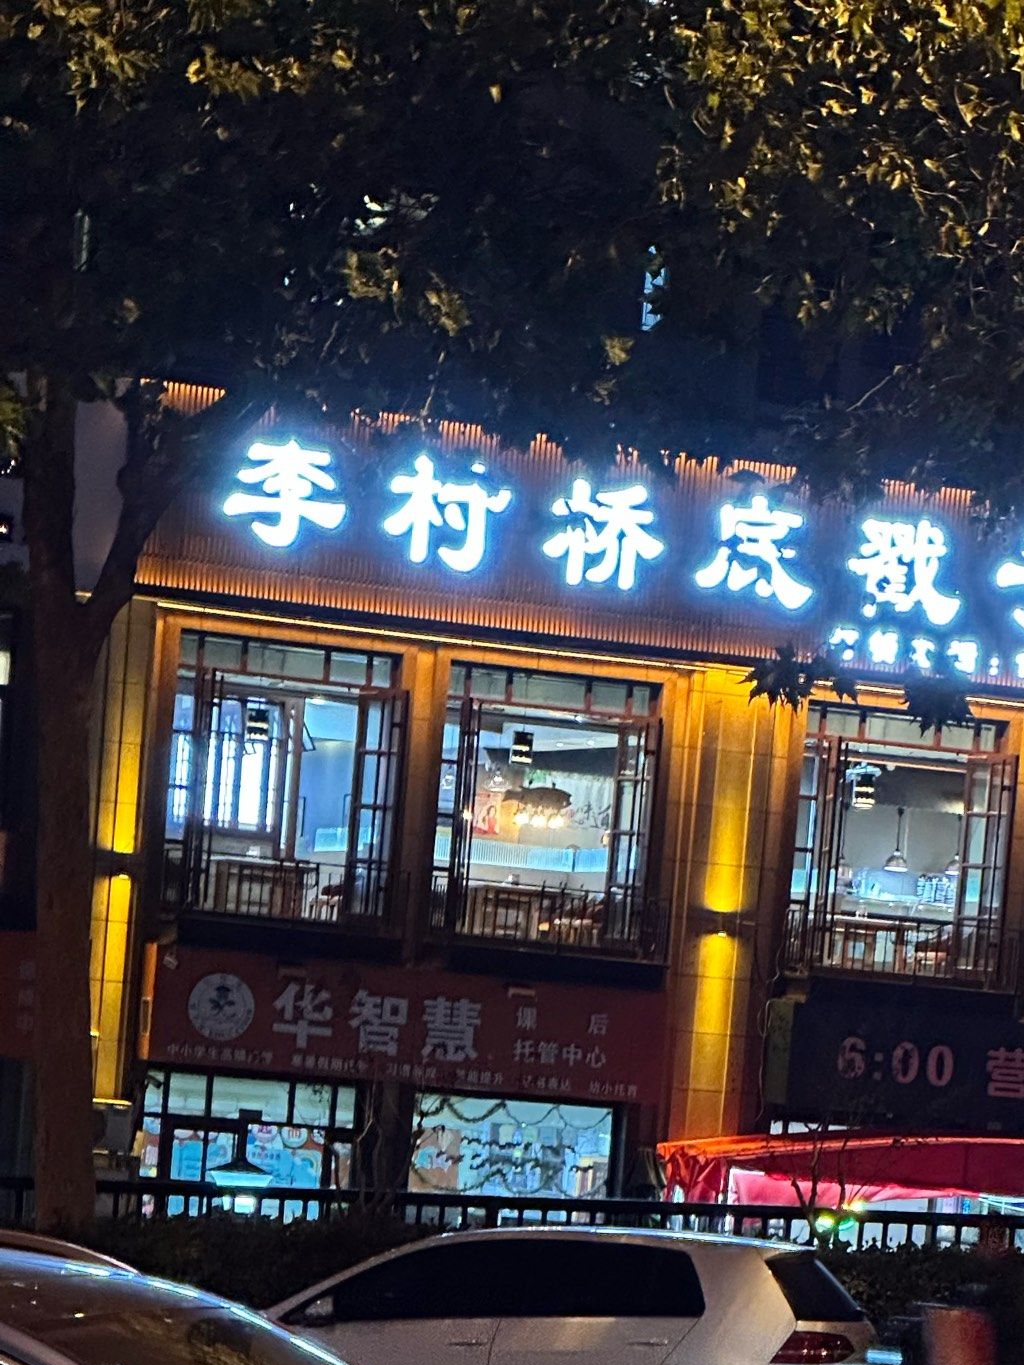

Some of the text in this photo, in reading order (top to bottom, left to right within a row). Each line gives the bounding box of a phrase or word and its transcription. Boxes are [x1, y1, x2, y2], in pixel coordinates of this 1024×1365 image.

[272, 981, 483, 1063] 华智慧
[513, 1038, 607, 1068] 托管中心
[836, 1036, 955, 1087] 6:00
